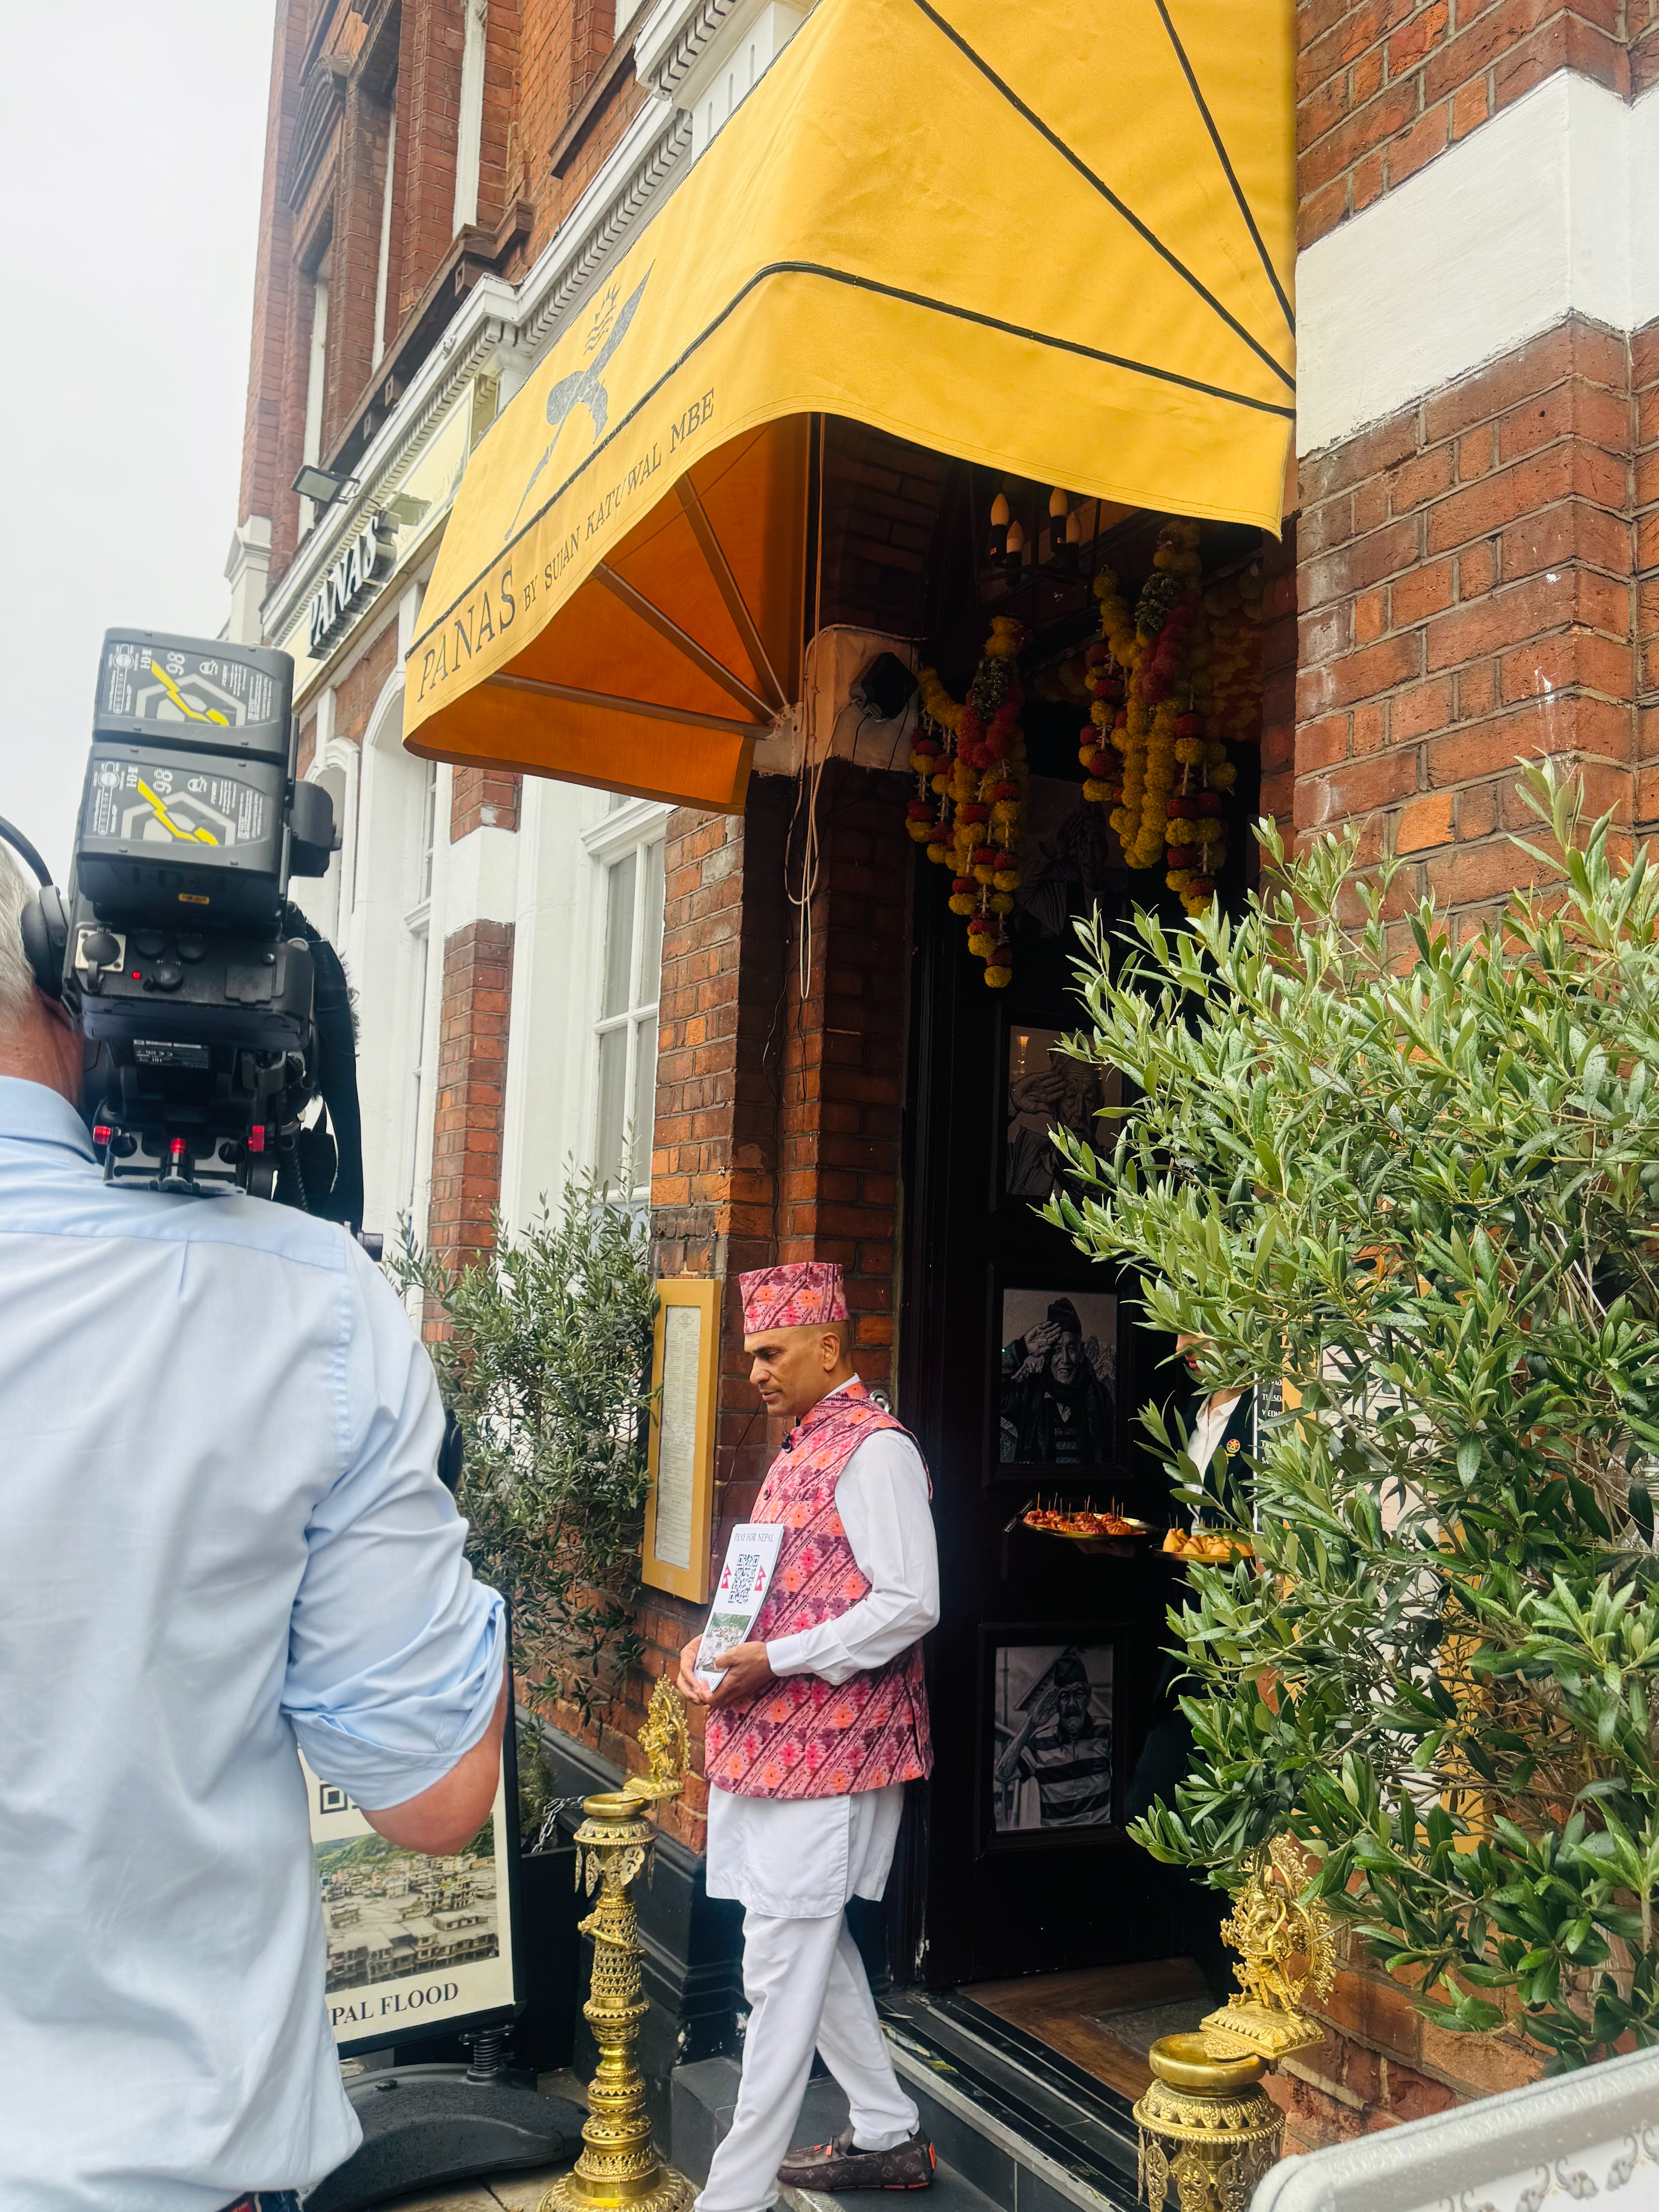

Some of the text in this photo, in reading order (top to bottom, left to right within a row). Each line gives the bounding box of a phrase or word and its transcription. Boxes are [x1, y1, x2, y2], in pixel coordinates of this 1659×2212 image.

[307, 515, 378, 654] PANAS
[417, 565, 516, 702] PANAS
[524, 575, 538, 611] BY
[585, 442, 661, 541] KATUWAL
[670, 387, 714, 453] MBE
[746, 1533, 756, 1541] FOR
[757, 1533, 774, 1542] NEPAL
[331, 1983, 459, 2026] PAL FLOOD
